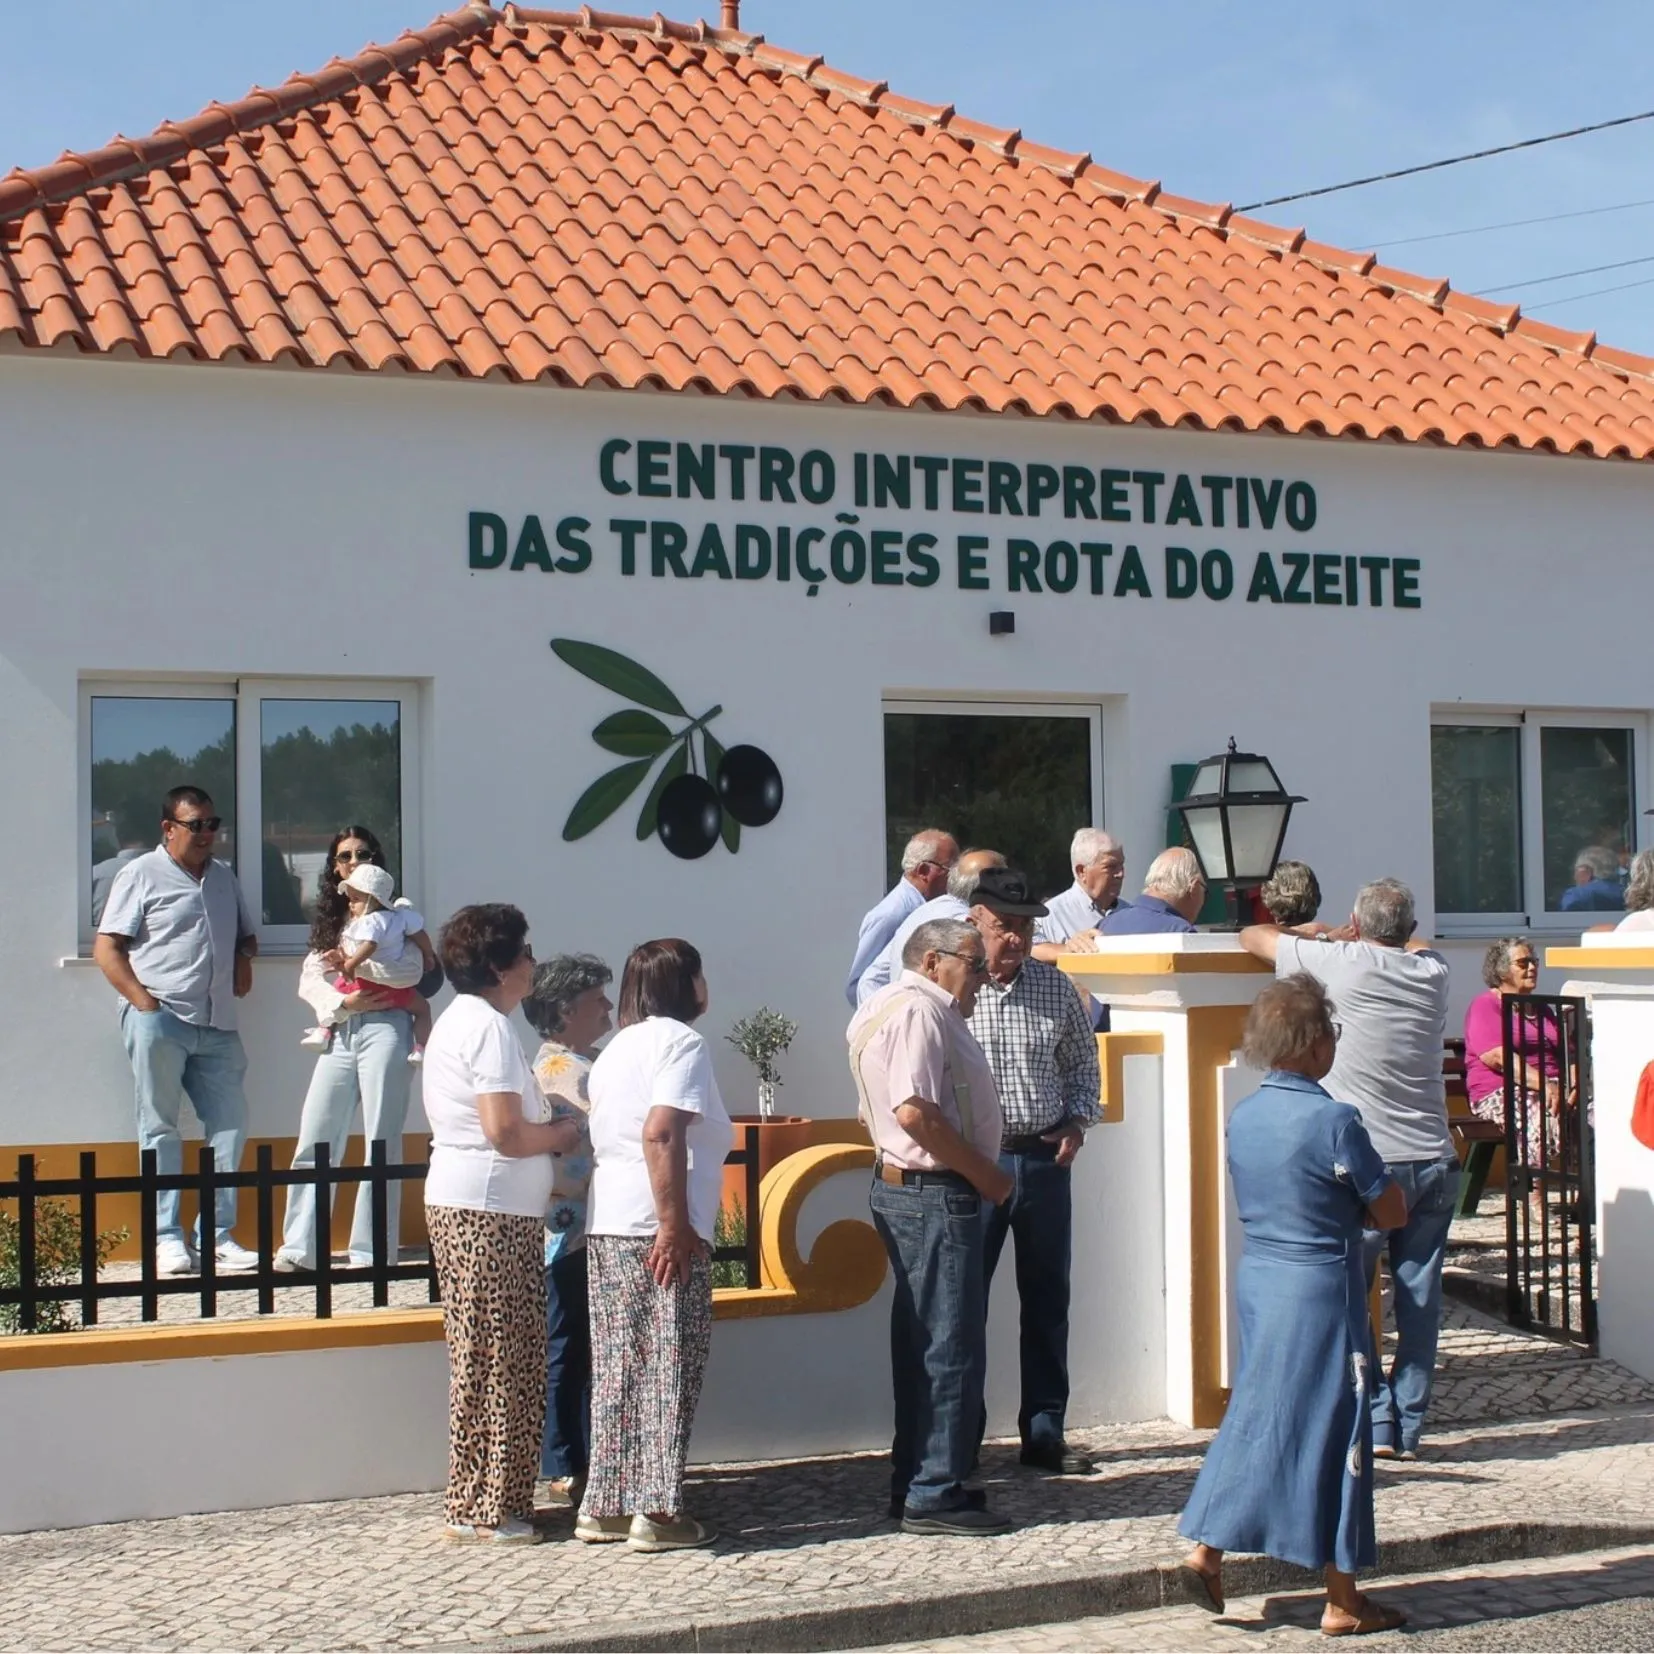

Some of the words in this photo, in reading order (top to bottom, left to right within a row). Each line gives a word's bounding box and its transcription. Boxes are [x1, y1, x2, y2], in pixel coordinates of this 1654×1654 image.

[598, 437, 836, 506] CENTRO
[853, 451, 1318, 533] INTERPRETATIVO
[468, 510, 593, 575] DAS
[608, 512, 941, 598] TRADIÇÕES
[956, 535, 991, 591] E
[1006, 538, 1153, 599] ROTA
[1164, 546, 1234, 602] DO
[1245, 551, 1422, 610] AZEITE
